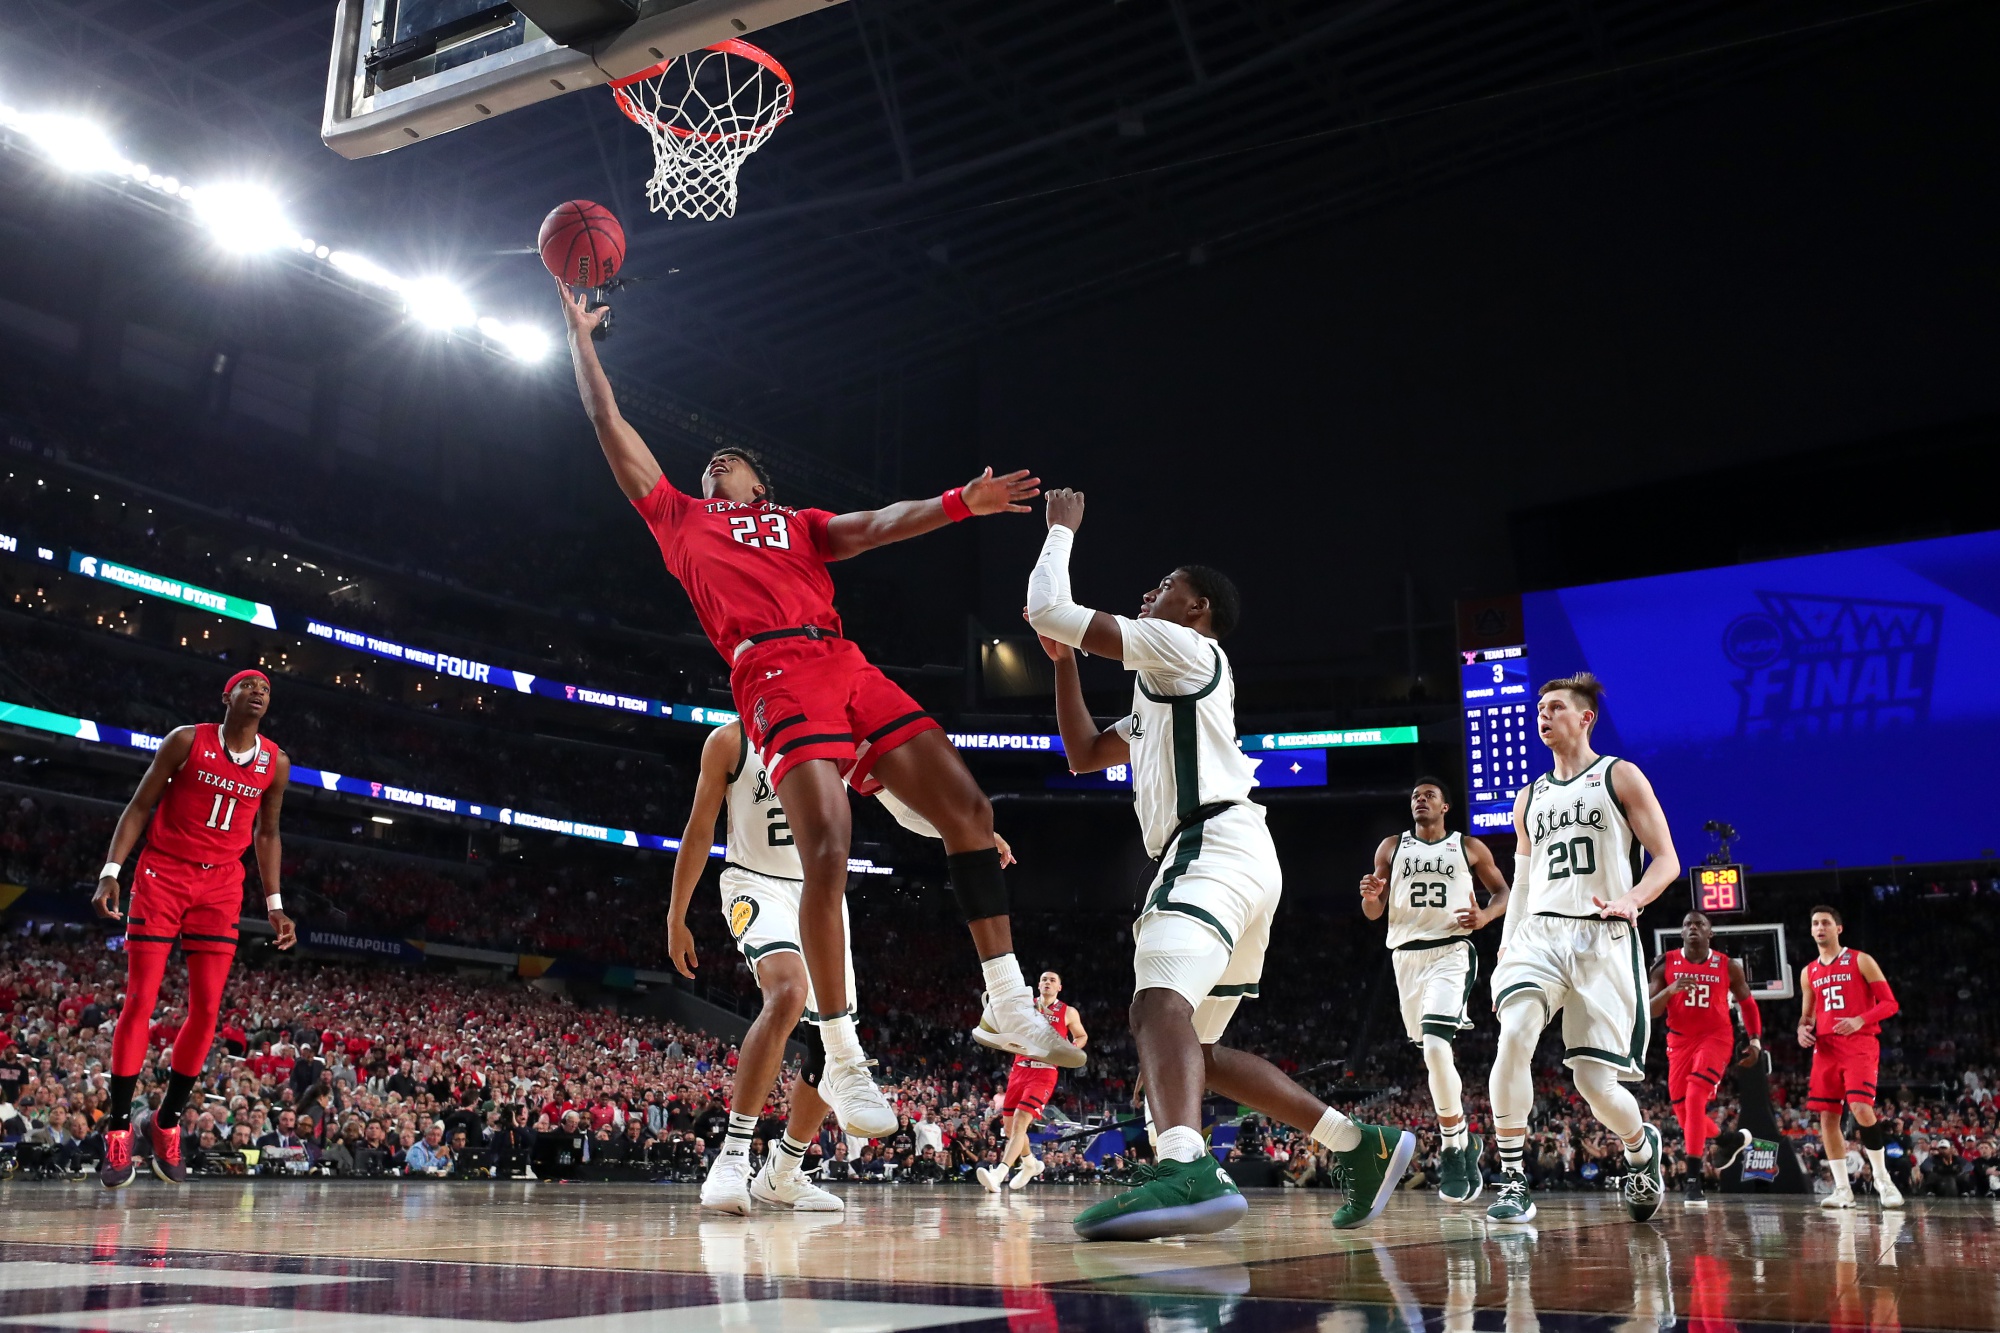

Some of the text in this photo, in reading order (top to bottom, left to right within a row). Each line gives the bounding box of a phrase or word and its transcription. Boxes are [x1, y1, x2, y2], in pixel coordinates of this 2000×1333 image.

[705, 501, 752, 513] TEXA
[729, 513, 790, 550] 23
[0, 534, 17, 552] CH
[101, 563, 181, 598] MICHIGAN
[183, 586, 226, 610] STATE
[307, 622, 490, 683] AND THEN THERE WERE FOUR
[1484, 648, 1522, 660] TEXAS TECH
[1492, 664, 1504, 683] 3
[1466, 688, 1494, 698] BONUS
[1744, 652, 1923, 719] FINAL
[578, 689, 616, 706] TEXAS
[617, 696, 647, 712] TECH
[1471, 716, 1524, 731] 11 3 0 0
[131, 732, 163, 750] WELC
[947, 734, 1050, 749] INNEAPOLIS
[1278, 731, 1381, 747] MICHIGAN STATE
[1491, 733, 1498, 743] 0
[1505, 732, 1511, 742] 0
[1519, 731, 1525, 740] 0
[1492, 748, 1498, 757] 0
[1506, 746, 1512, 756] 0
[1520, 745, 1526, 755] 0
[1106, 764, 1127, 781] 68
[1493, 762, 1499, 772] 0
[1507, 761, 1513, 770] 0
[1521, 759, 1527, 769] 0
[197, 770, 262, 798] TEXAS TECH
[1494, 776, 1500, 786] 0
[1508, 775, 1514, 785] 1
[1521, 774, 1528, 783] 0
[206, 794, 237, 831] 11
[384, 786, 423, 806] TEXAS
[425, 795, 455, 812] TECH
[514, 813, 573, 834] MICHIGAN
[574, 823, 607, 840] STATE
[1473, 811, 1514, 827] #FINALF
[1533, 797, 1607, 846] State
[767, 808, 794, 846] 2
[1547, 836, 1596, 880] 20
[1402, 855, 1456, 880] State
[1701, 869, 1737, 885] 18:28
[1410, 882, 1447, 908] 23
[1703, 884, 1736, 910] 28
[310, 931, 401, 955] MINNEAPOLIS
[1700, 974, 1720, 983] TECH
[1812, 973, 1852, 988] TEXAS TECH
[1684, 984, 1710, 1008] 32
[1822, 985, 1845, 1012] 25
[1745, 1159, 1774, 1169] FOUR
[1746, 1150, 1775, 1160] FINAL
